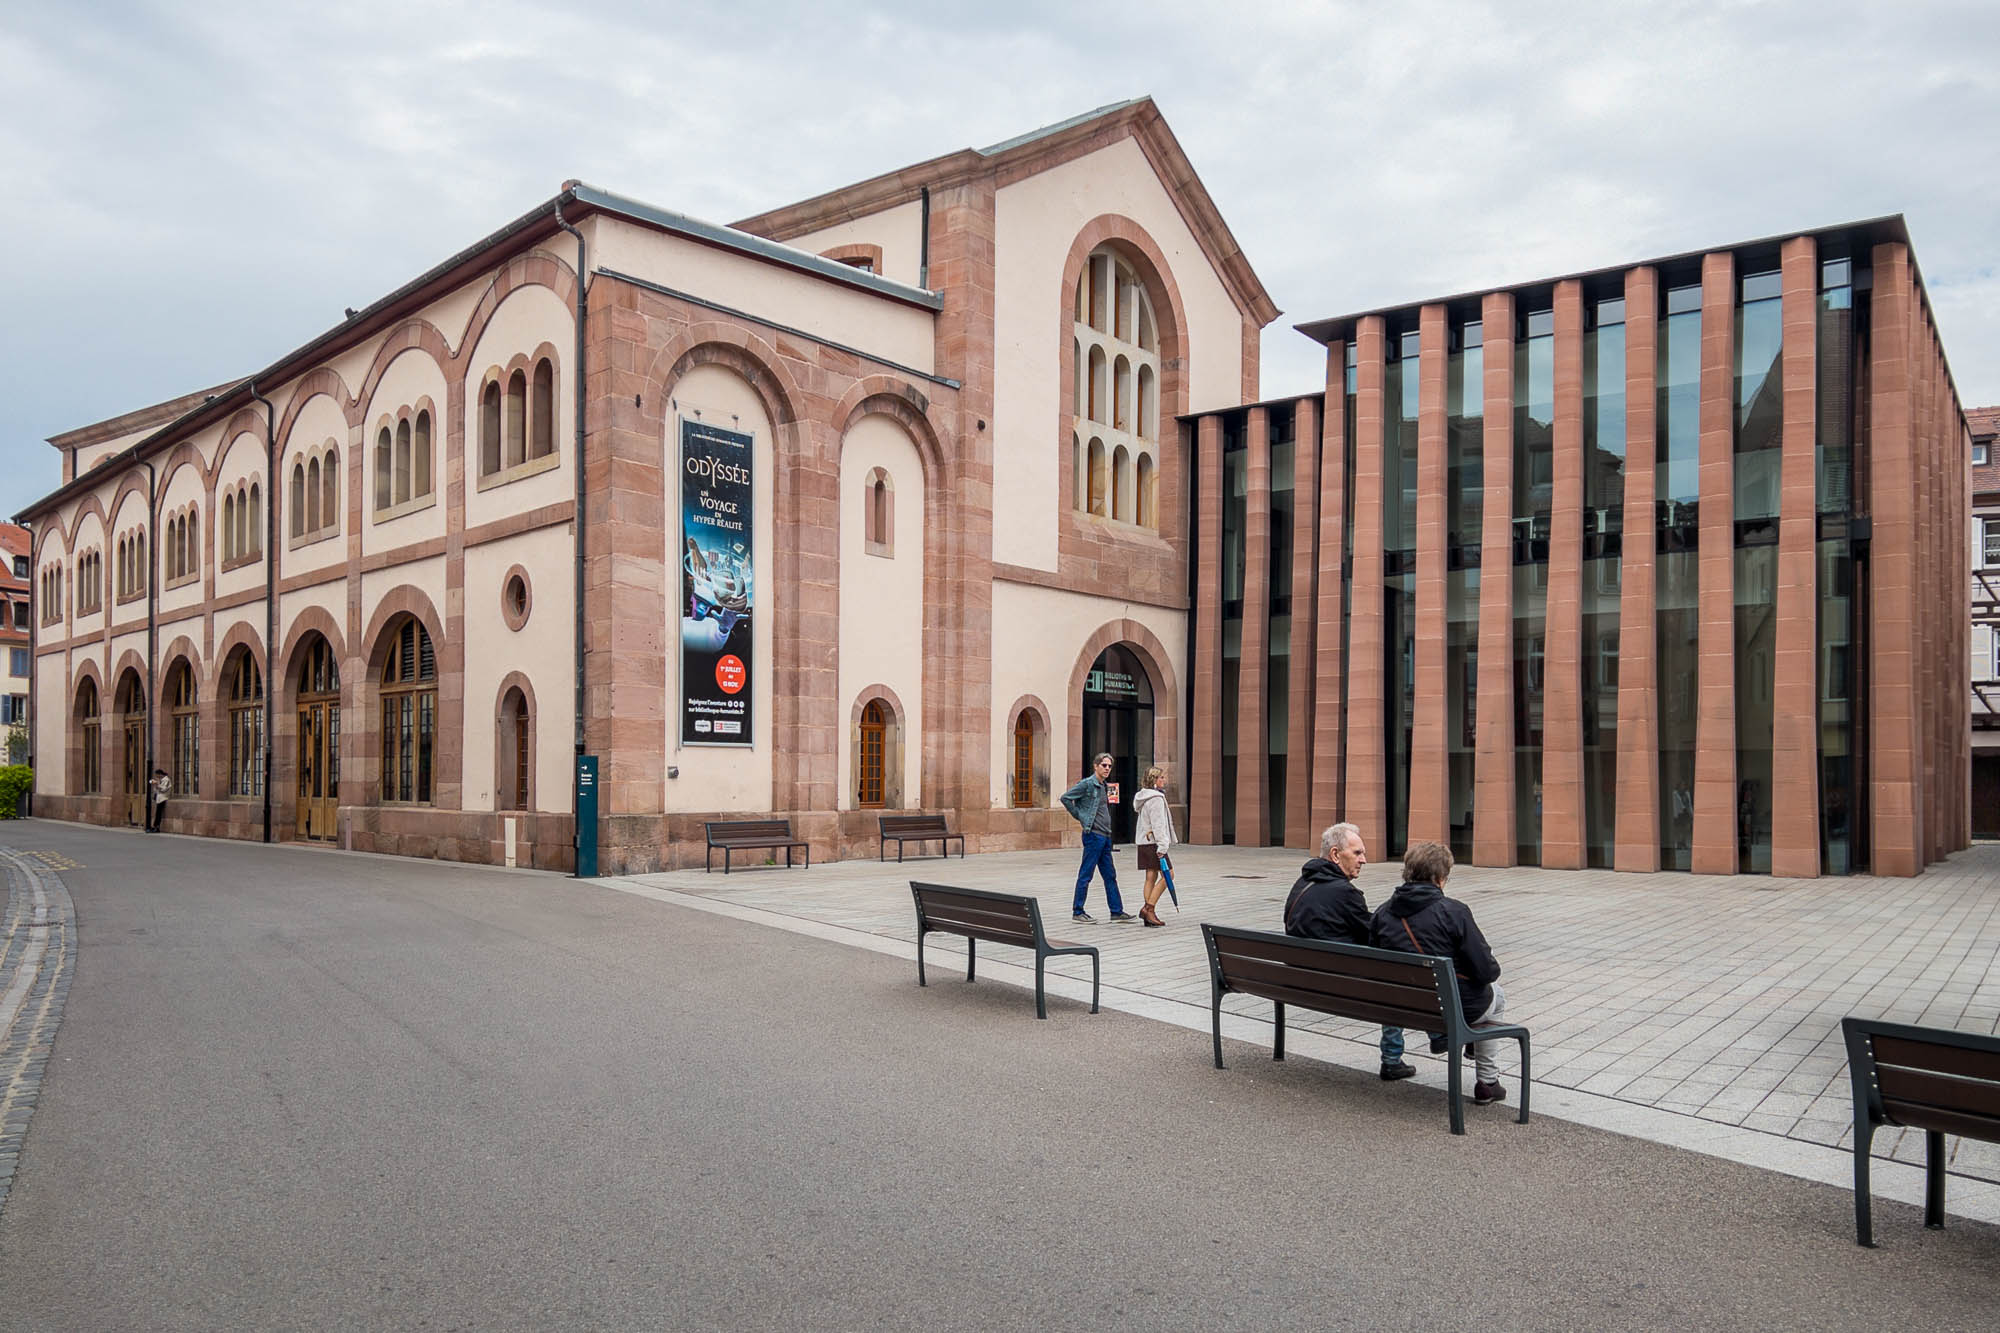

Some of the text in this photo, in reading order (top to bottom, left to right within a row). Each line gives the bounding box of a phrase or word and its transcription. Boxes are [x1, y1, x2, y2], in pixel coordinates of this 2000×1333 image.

[686, 455, 750, 488] ODYSSÉE
[699, 496, 738, 514] VOYAGE
[693, 514, 743, 531] HYPER RÉALITÉ
